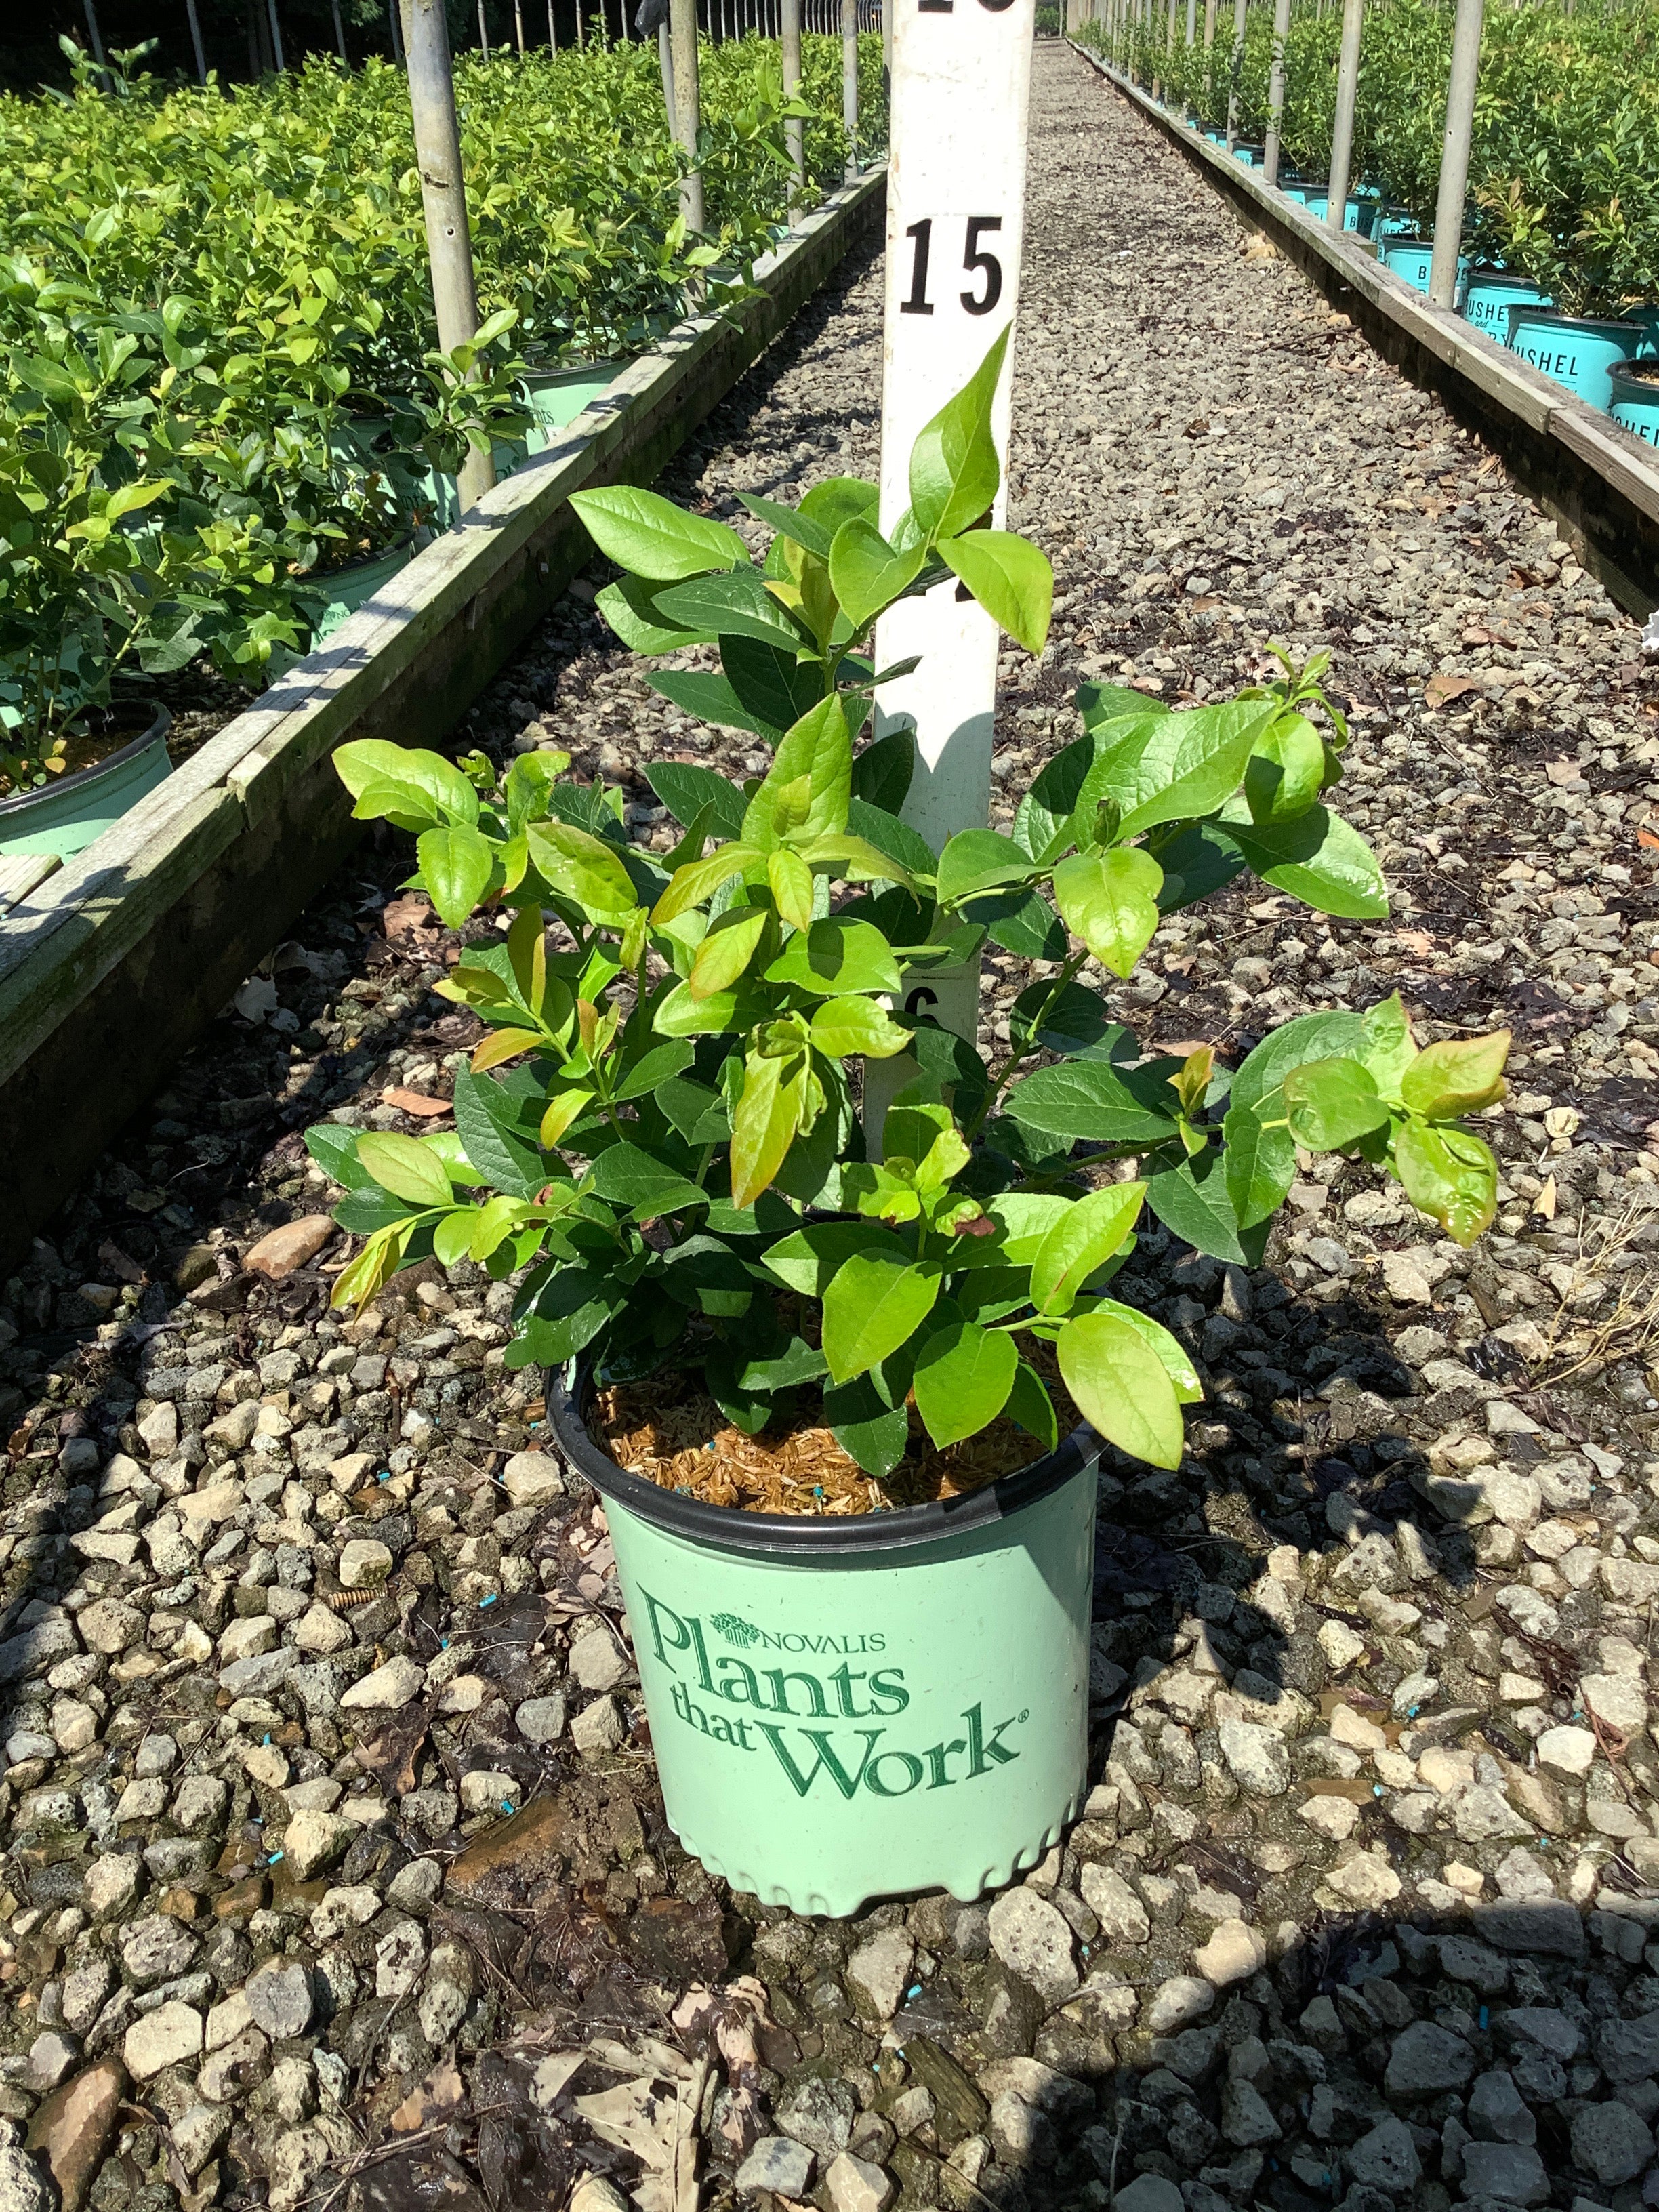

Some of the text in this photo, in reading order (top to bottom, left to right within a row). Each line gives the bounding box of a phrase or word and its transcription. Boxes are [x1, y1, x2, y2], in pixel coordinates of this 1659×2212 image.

[900, 216, 1002, 316] 15
[636, 1580, 911, 1719] Plants
[762, 1632, 886, 1654] NOVALIS
[668, 1681, 758, 1751] that
